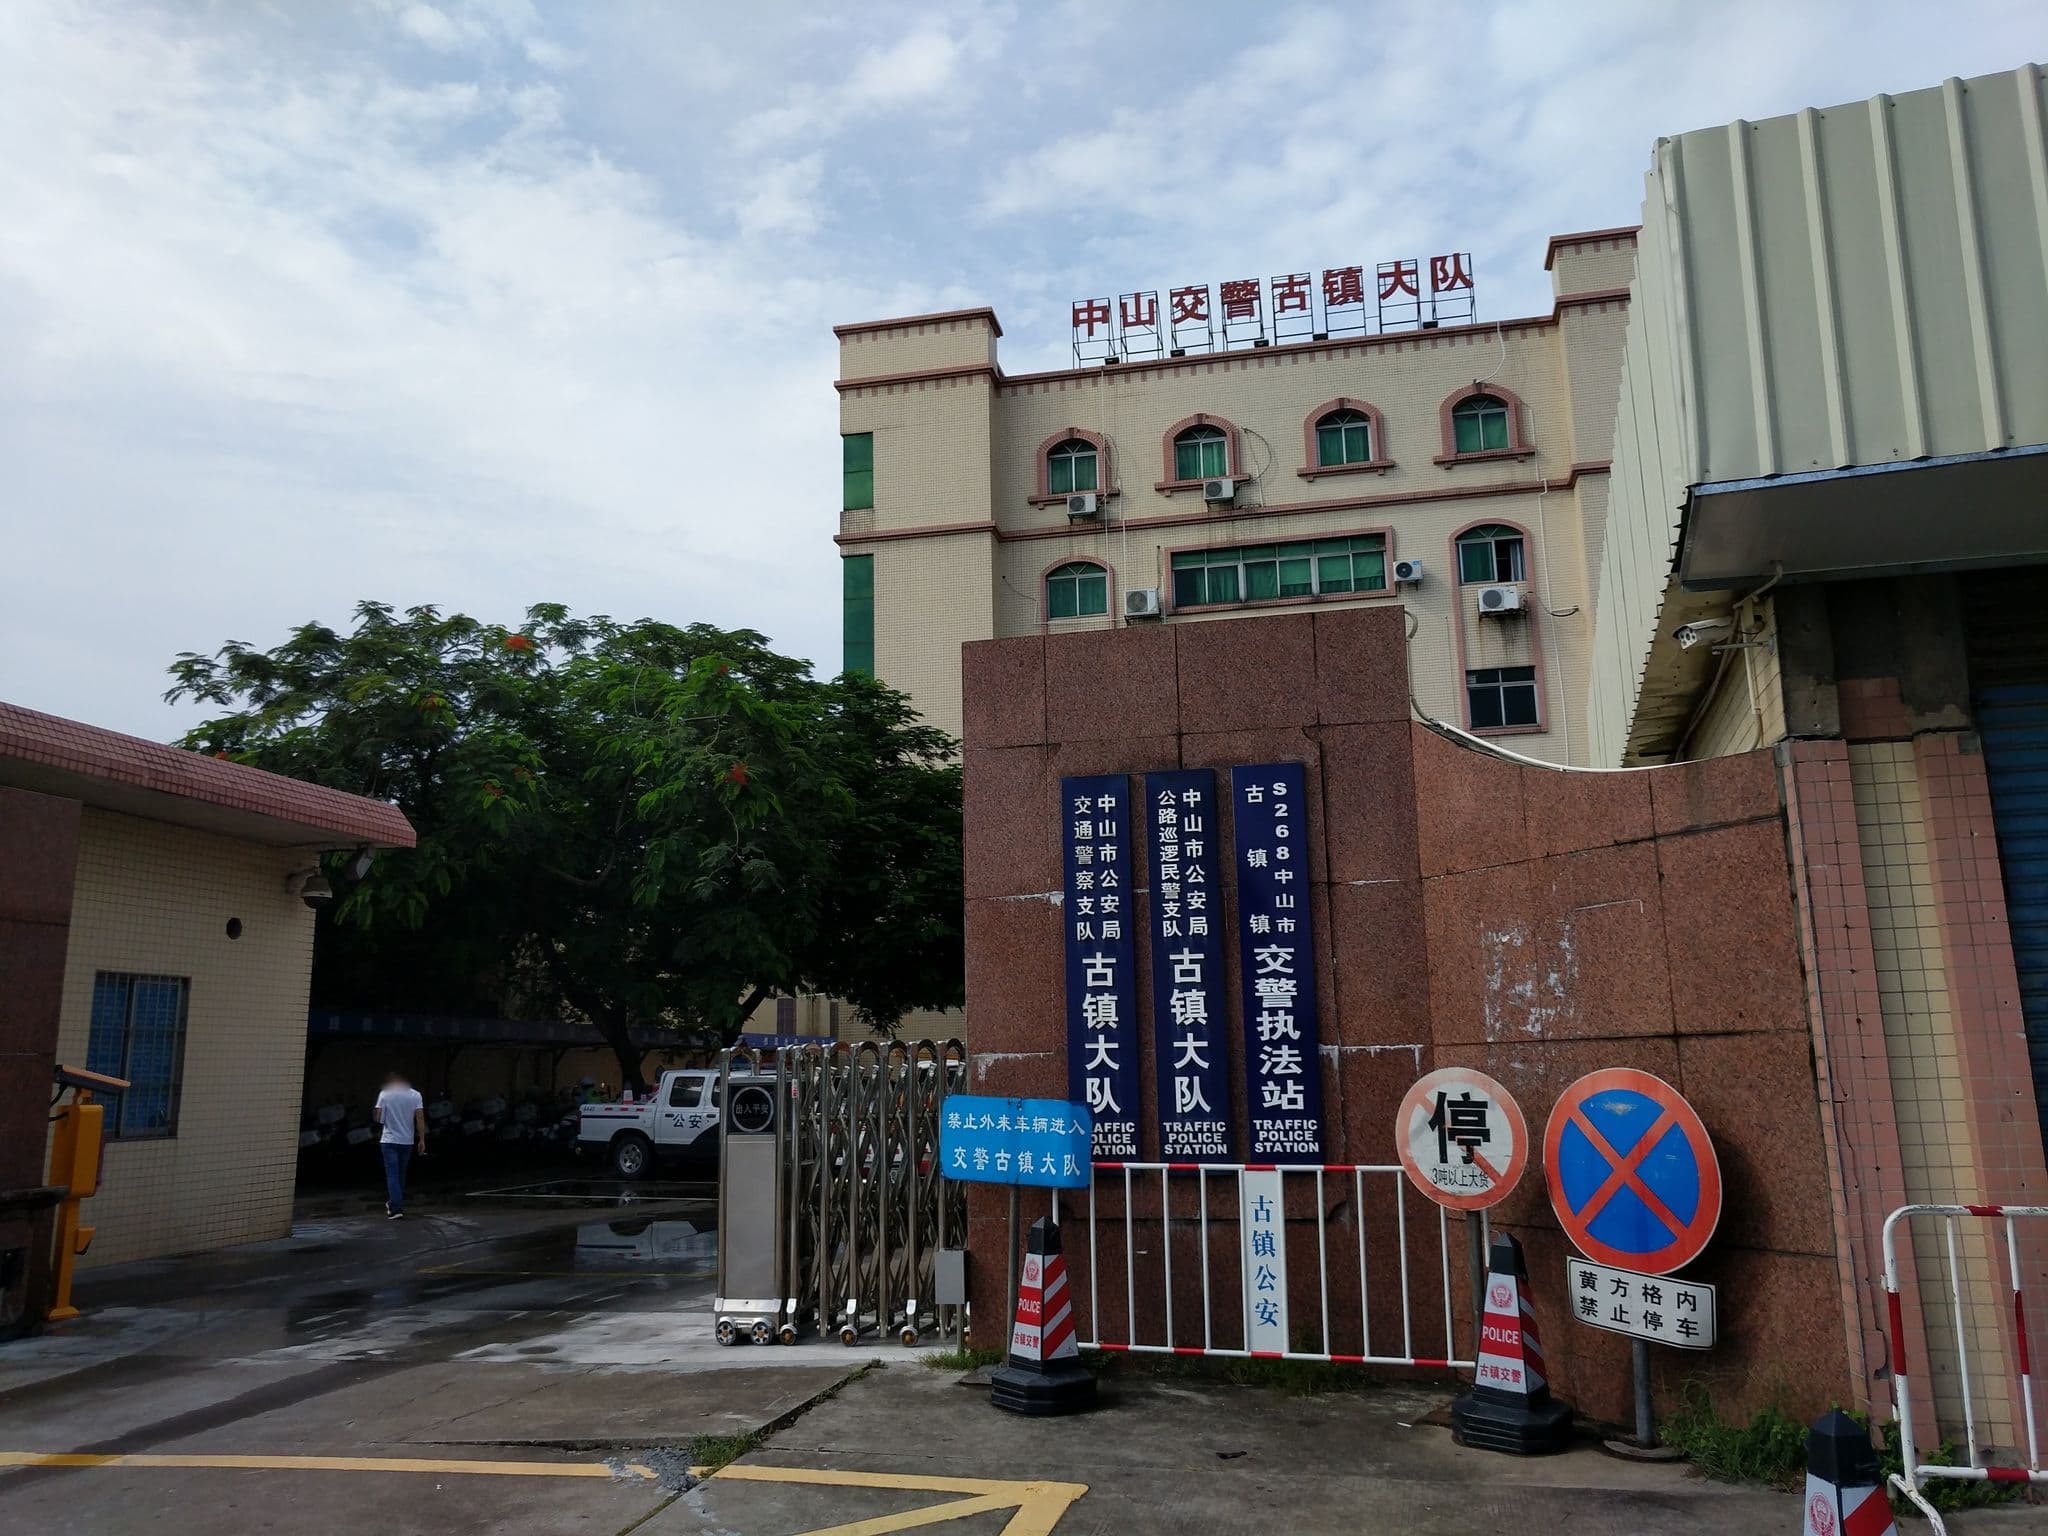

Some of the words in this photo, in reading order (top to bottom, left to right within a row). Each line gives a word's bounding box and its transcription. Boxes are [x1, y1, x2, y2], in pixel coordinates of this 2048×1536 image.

[1072, 253, 1474, 337] 中山交警古镇大队
[1074, 796, 1096, 942] 交通警察支队
[1098, 794, 1121, 941] 中山市公安局
[1157, 790, 1182, 938] 公路巡逻民警支队
[1182, 789, 1209, 937] 中山市公安局
[1245, 784, 1270, 935] 古镇镇
[1272, 782, 1296, 934] S268中山市
[1082, 952, 1121, 1114] 古镇大队
[1169, 948, 1211, 1113] 古镇大队
[1253, 944, 1305, 1110] 交警执法站
[673, 1113, 702, 1129] 公安
[735, 1103, 769, 1115] 出入平安
[947, 1112, 1086, 1136] 禁止外来车辆进入
[1093, 1122, 1136, 1133] AFFIC
[1163, 1121, 1227, 1132] TRAFFIC
[1253, 1119, 1318, 1131] TRAFFIC
[1258, 1130, 1314, 1142] POLICE
[1428, 1091, 1491, 1165] 停
[1091, 1133, 1132, 1144] OLICE
[1092, 1144, 1137, 1155] ATION
[1164, 1144, 1227, 1155] STATION
[1168, 1132, 1223, 1143] POLICE
[1254, 1141, 1320, 1153] STATION
[952, 1146, 1081, 1177] 交警古镇大队
[1431, 1167, 1489, 1189] 3吨以上大货
[1250, 1195, 1280, 1328] 古镇公安
[1578, 1269, 1697, 1313] 黄方格内
[1018, 1297, 1041, 1314] POLICE
[1579, 1295, 1700, 1339] 禁止停车
[1482, 1325, 1519, 1345] POLICE
[1479, 1362, 1522, 1385] 古镇交警
